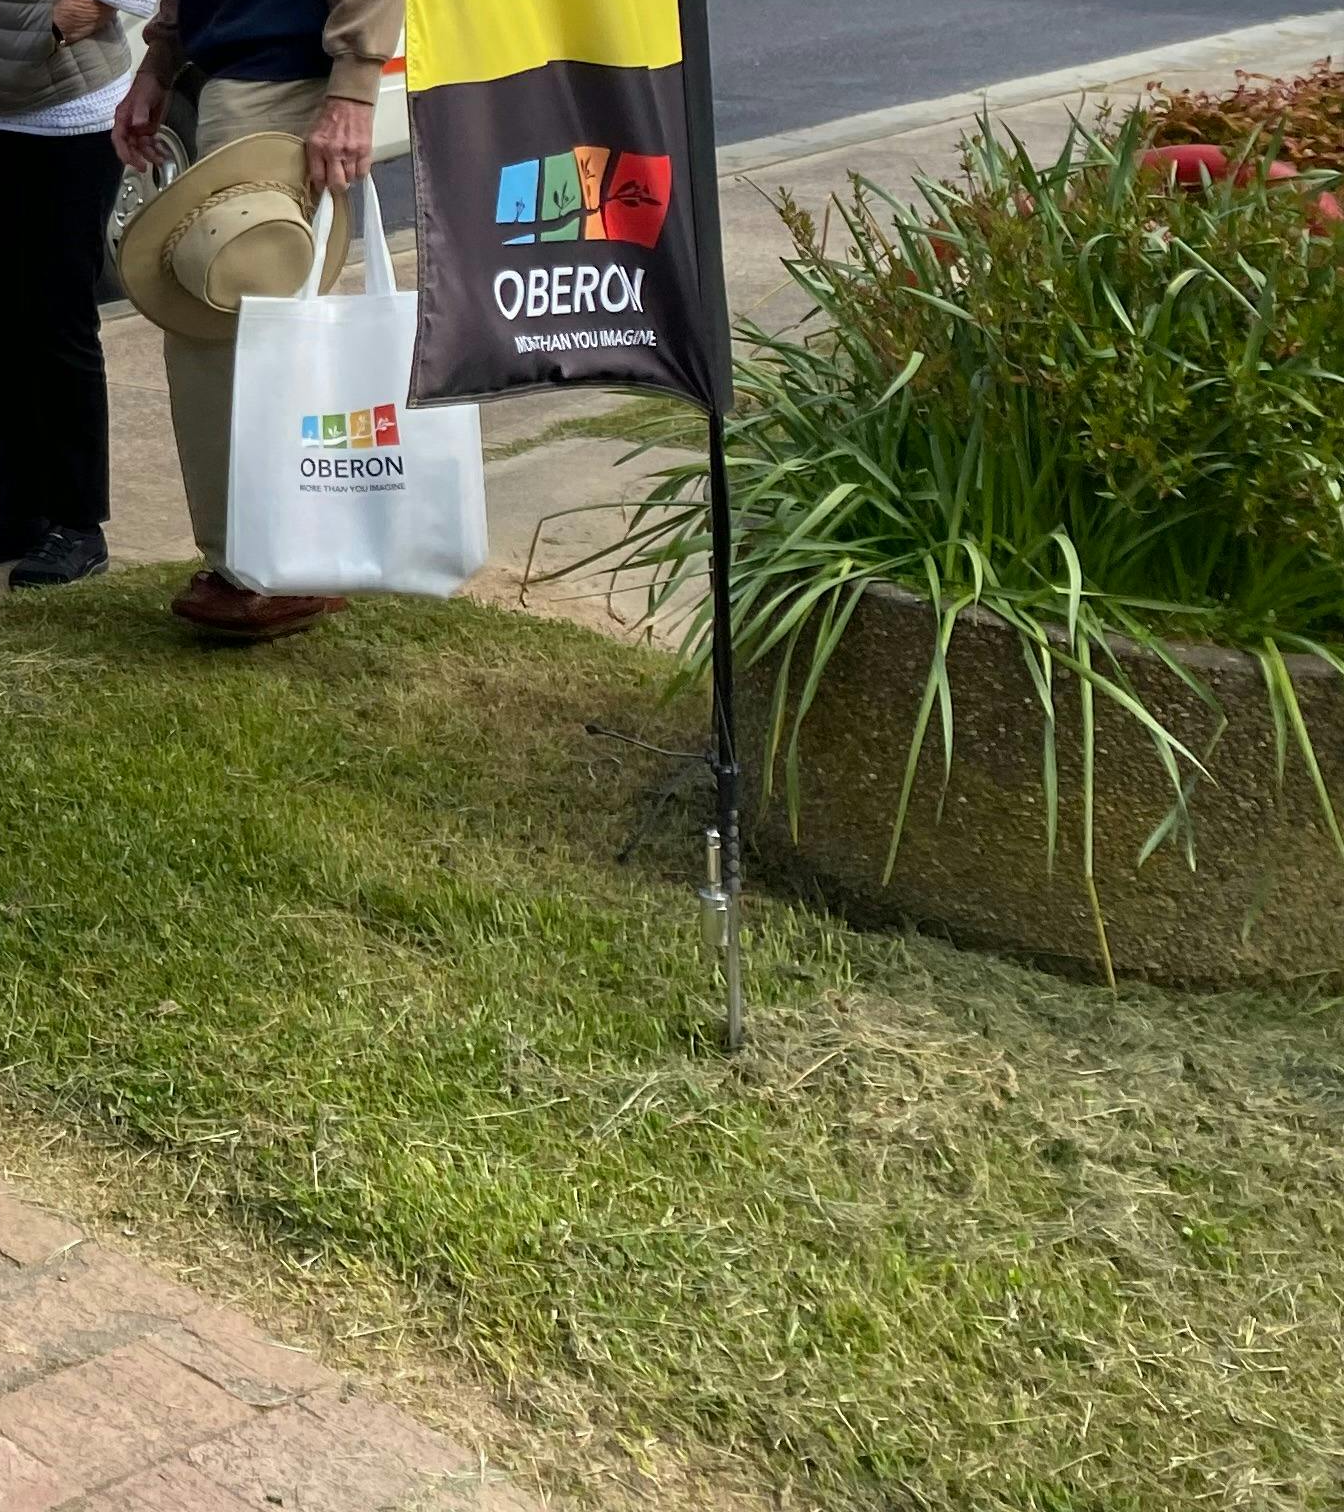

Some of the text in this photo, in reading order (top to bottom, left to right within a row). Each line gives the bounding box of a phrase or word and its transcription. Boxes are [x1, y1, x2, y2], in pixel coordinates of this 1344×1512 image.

[493, 263, 646, 321] OBERON
[570, 330, 599, 349] YOU
[599, 329, 658, 347] IMAGINE
[301, 455, 404, 479] OBERON
[323, 484, 348, 494] THAN
[348, 485, 369, 494] YOU
